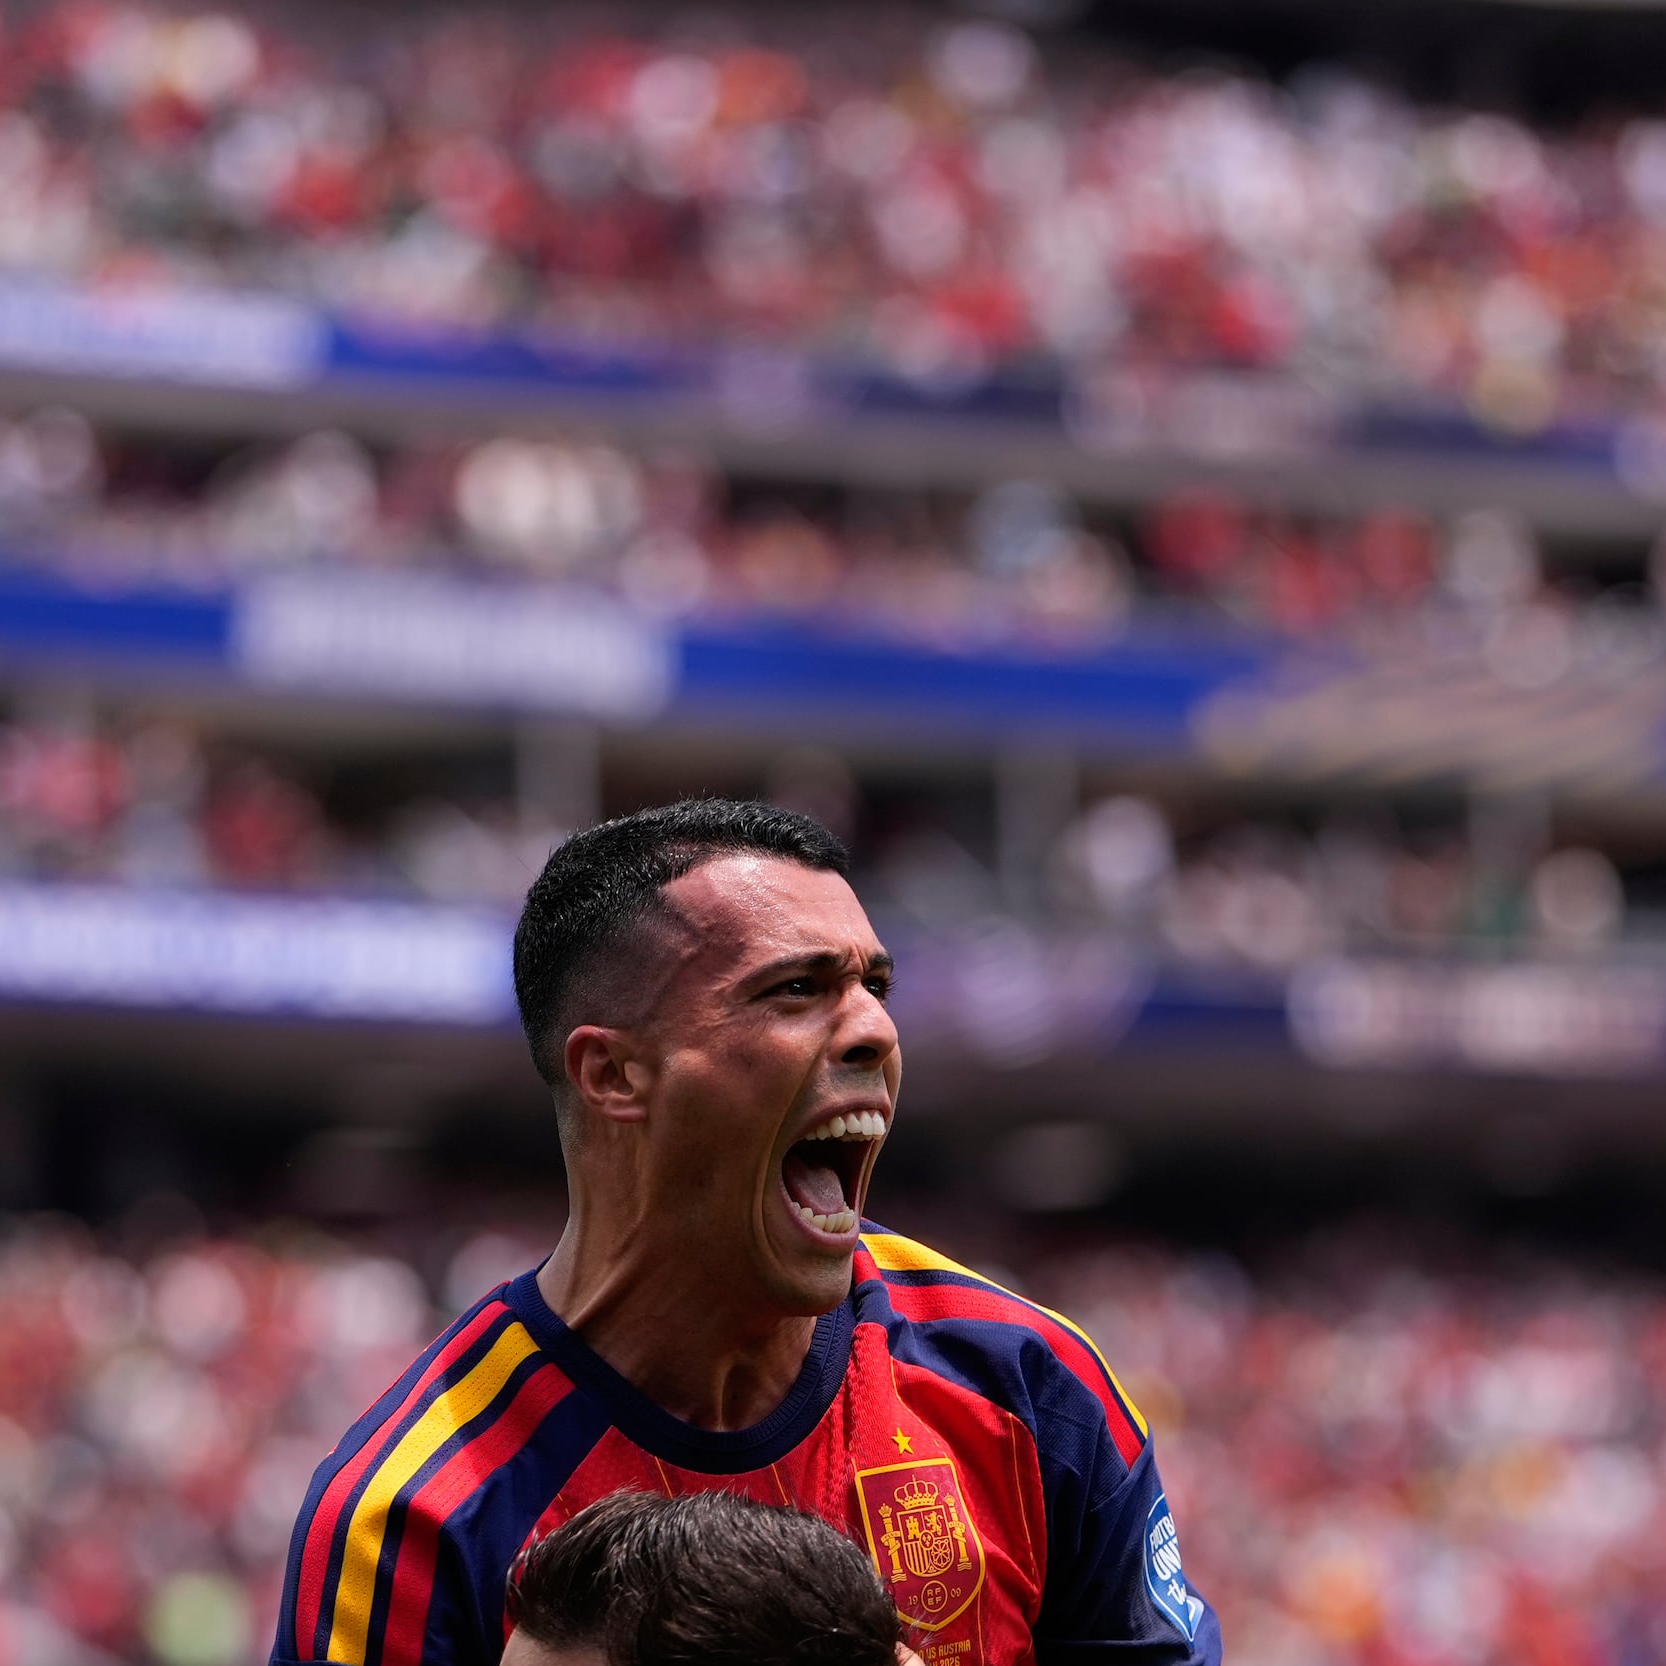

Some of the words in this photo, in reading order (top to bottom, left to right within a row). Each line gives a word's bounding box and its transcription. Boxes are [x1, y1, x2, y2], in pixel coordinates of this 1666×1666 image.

[909, 1595, 919, 1606] 19
[950, 1587, 962, 1598] 09
[938, 1639, 971, 1657] AUSTRIA
